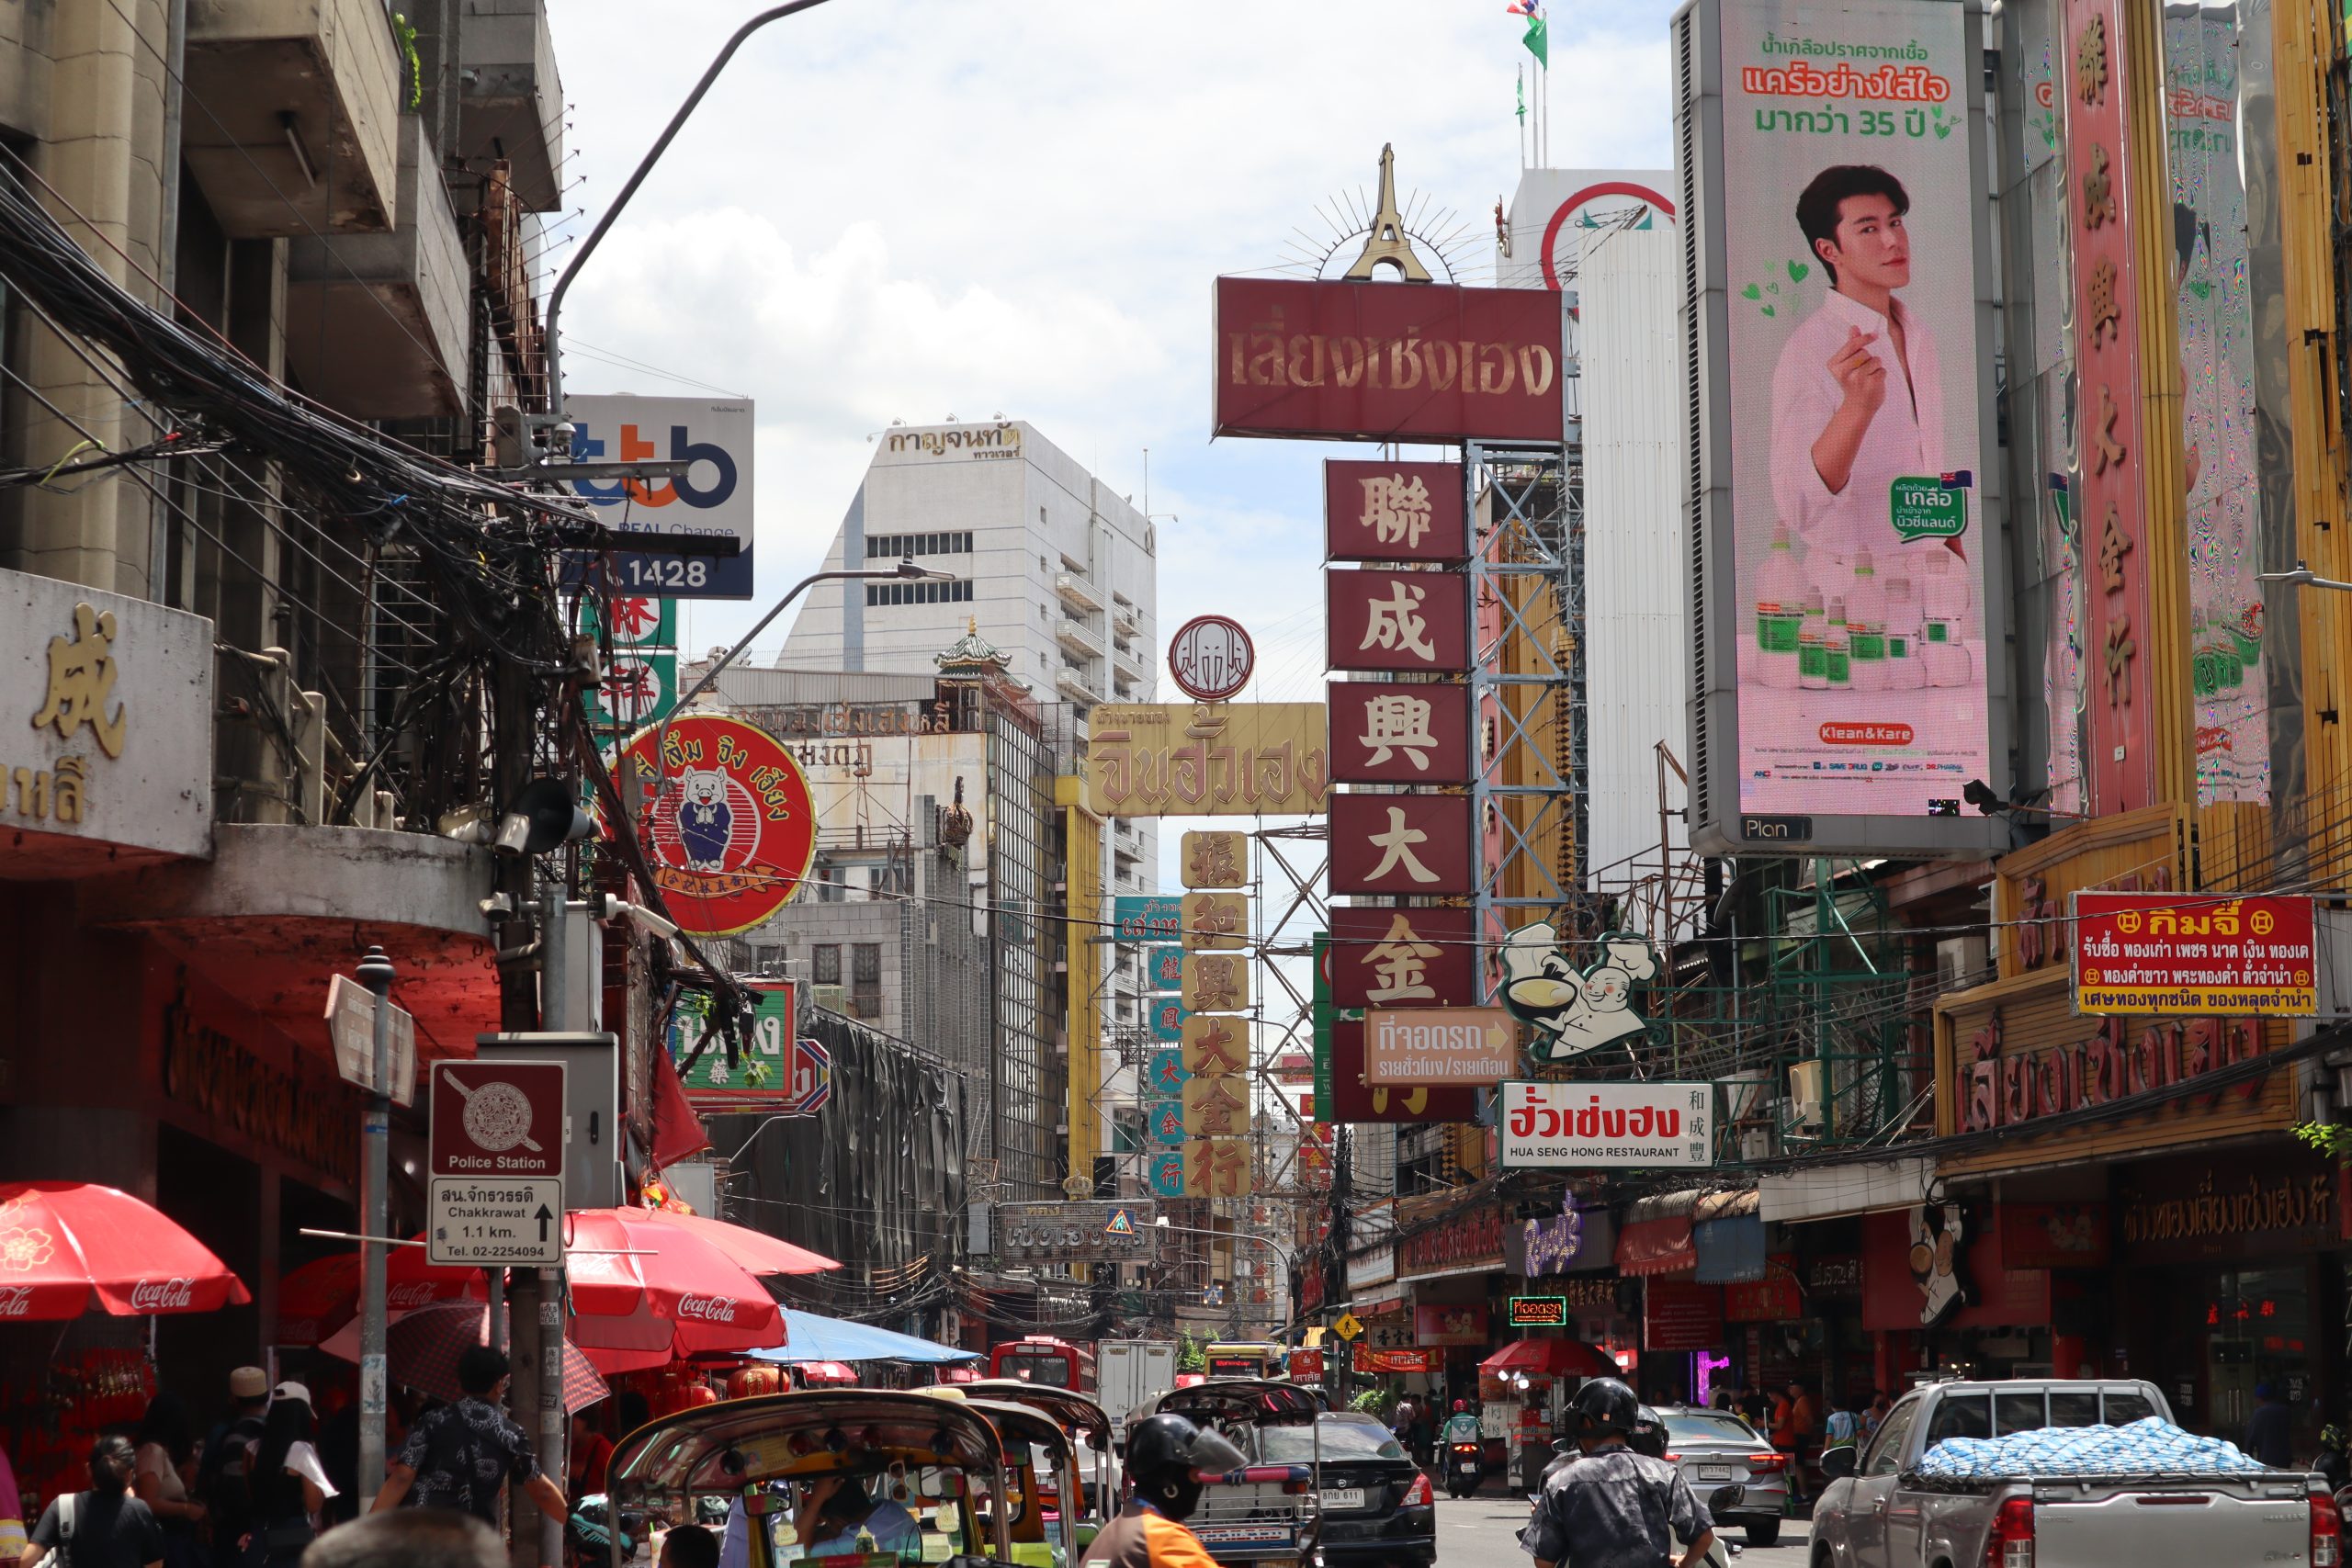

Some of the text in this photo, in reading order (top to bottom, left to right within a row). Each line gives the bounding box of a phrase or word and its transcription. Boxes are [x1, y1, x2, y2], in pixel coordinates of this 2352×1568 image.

[1744, 62, 1950, 101] แคร์อย่างใส่ใจ
[1756, 104, 1926, 138] มากว่า 35 ปี
[570, 423, 738, 508] ttb
[973, 445, 1021, 459] ทาวเวอร์
[1905, 487, 1952, 507] เกลือ
[629, 558, 707, 587] 1428
[1358, 472, 1445, 1114] 聯成興大金
[1746, 819, 1788, 839] Plan
[2083, 930, 2309, 960] รับซื้อ ทองเก่า เพชร นาค เงิน ทองเค
[2103, 959, 2292, 986] ทองคำขาว พระทองคำ ตั๋วจำนำ
[1187, 831, 1245, 1196] 振和興大金行
[2084, 988, 2312, 1013] เศษทองทุกชนิด ของหลุดจำนำ
[1379, 1014, 1482, 1051] ที่จอดรถ
[1510, 1086, 1680, 1138] ฮั่วเซ่งฮง
[449, 1156, 546, 1169] Police Station
[1510, 1147, 1679, 1158] HUA SENG HONG RESTAURANT
[441, 1186, 534, 1202] สน.จักรวรรดิ
[448, 1207, 526, 1218] Chakkrawat
[462, 1226, 516, 1237] 1.1 km.
[447, 1247, 545, 1257] Tel. 02-2254094
[131, 1278, 196, 1311] Coca-Cola
[676, 1291, 738, 1323] Coca-Cola
